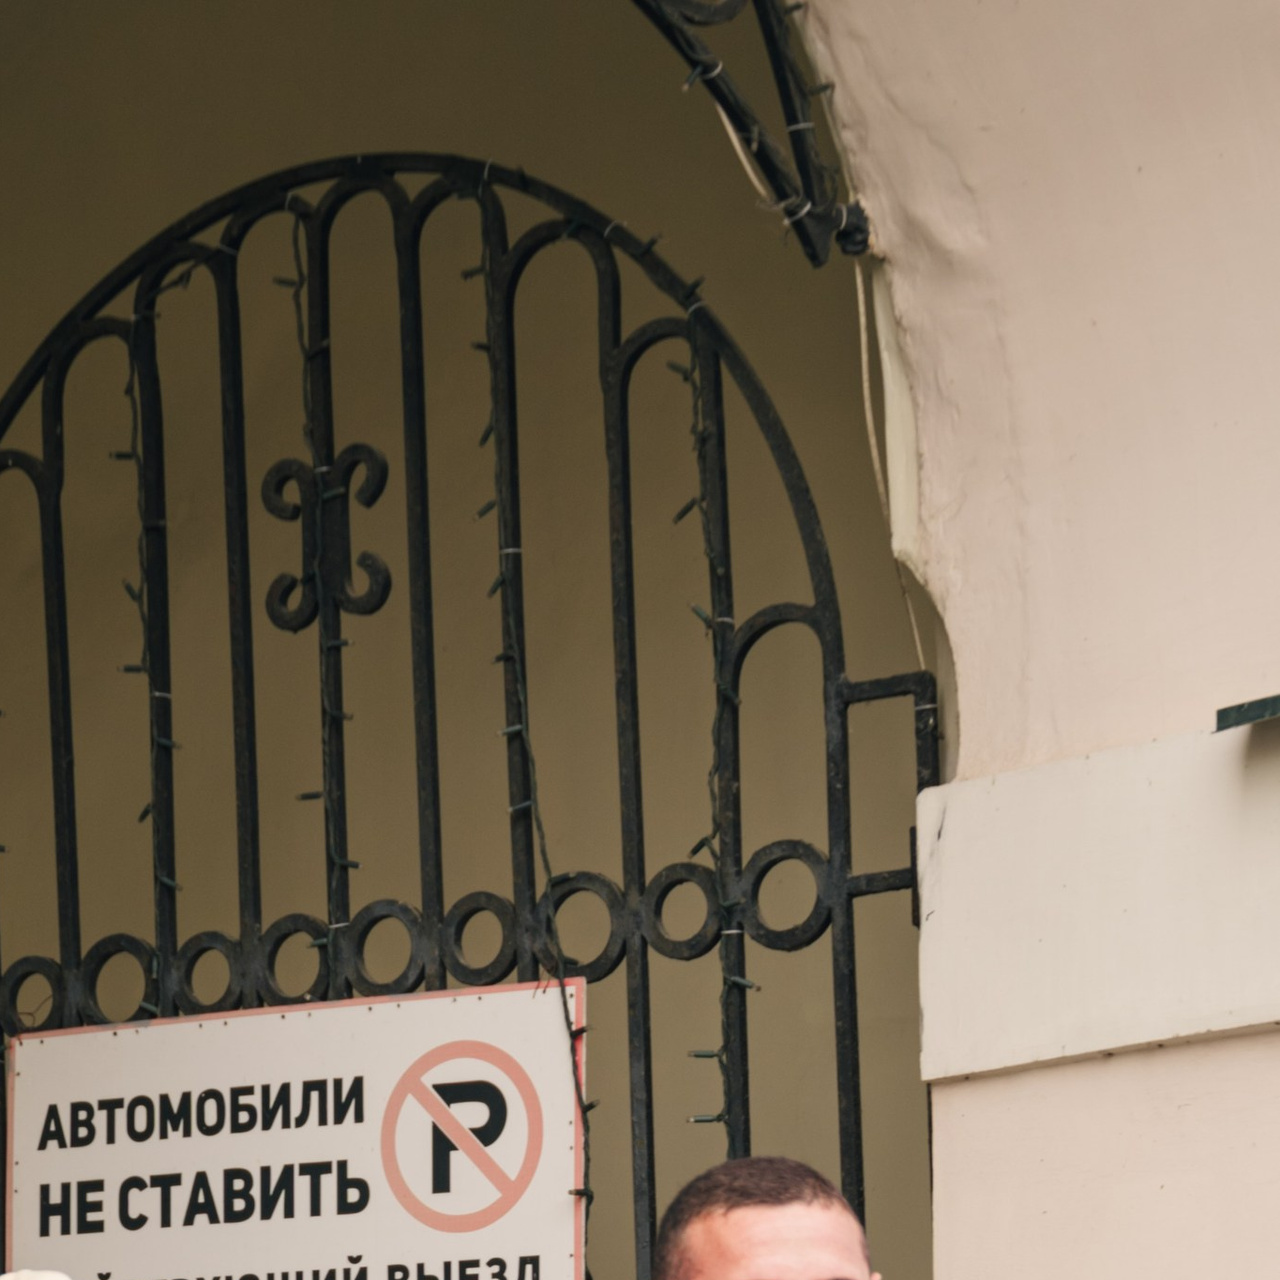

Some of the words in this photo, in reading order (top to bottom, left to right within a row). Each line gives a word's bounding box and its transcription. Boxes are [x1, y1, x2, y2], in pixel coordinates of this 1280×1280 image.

[37, 1075, 365, 1151] АВТОМОБИЛИ
[39, 1178, 106, 1238] НЕ
[118, 1159, 371, 1232] СТАВИТЬ
